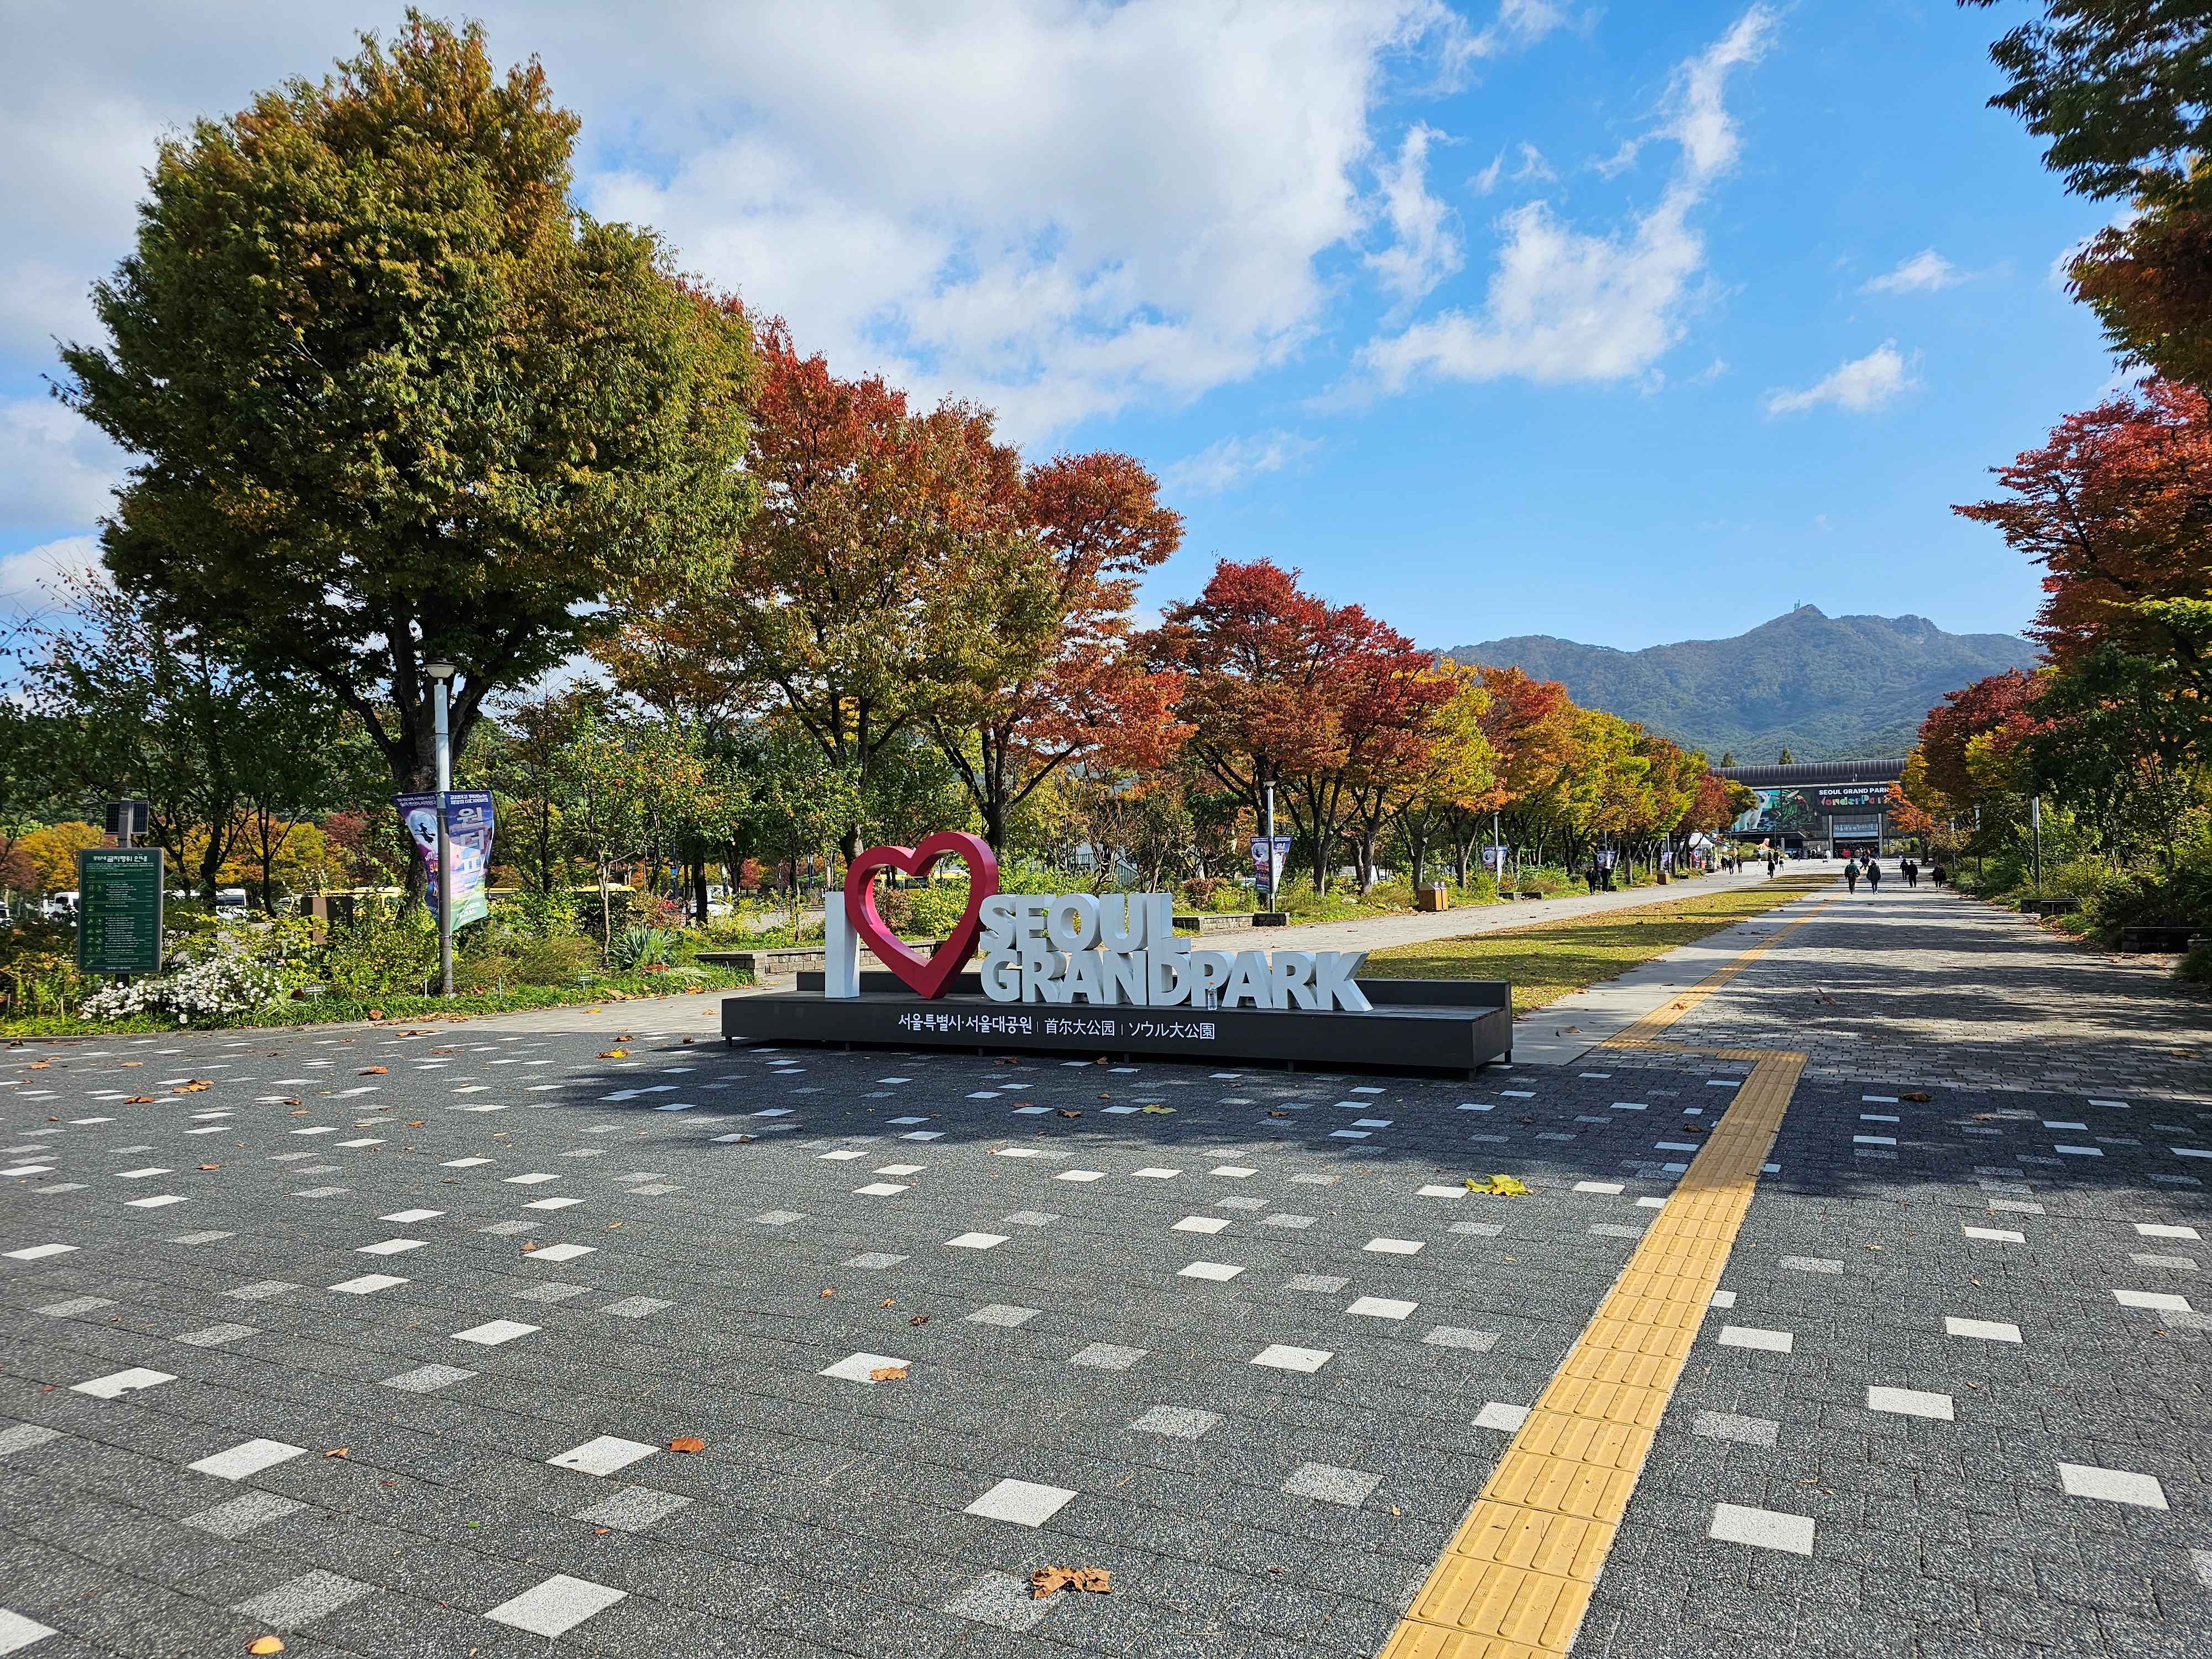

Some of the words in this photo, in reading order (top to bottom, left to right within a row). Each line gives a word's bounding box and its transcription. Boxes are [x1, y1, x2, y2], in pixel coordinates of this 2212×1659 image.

[825, 891, 860, 999] I
[979, 893, 1191, 953] SEOUL
[1044, 1017, 1115, 1036] 首尔大公园
[1128, 1021, 1215, 1040] ソウル大公園
